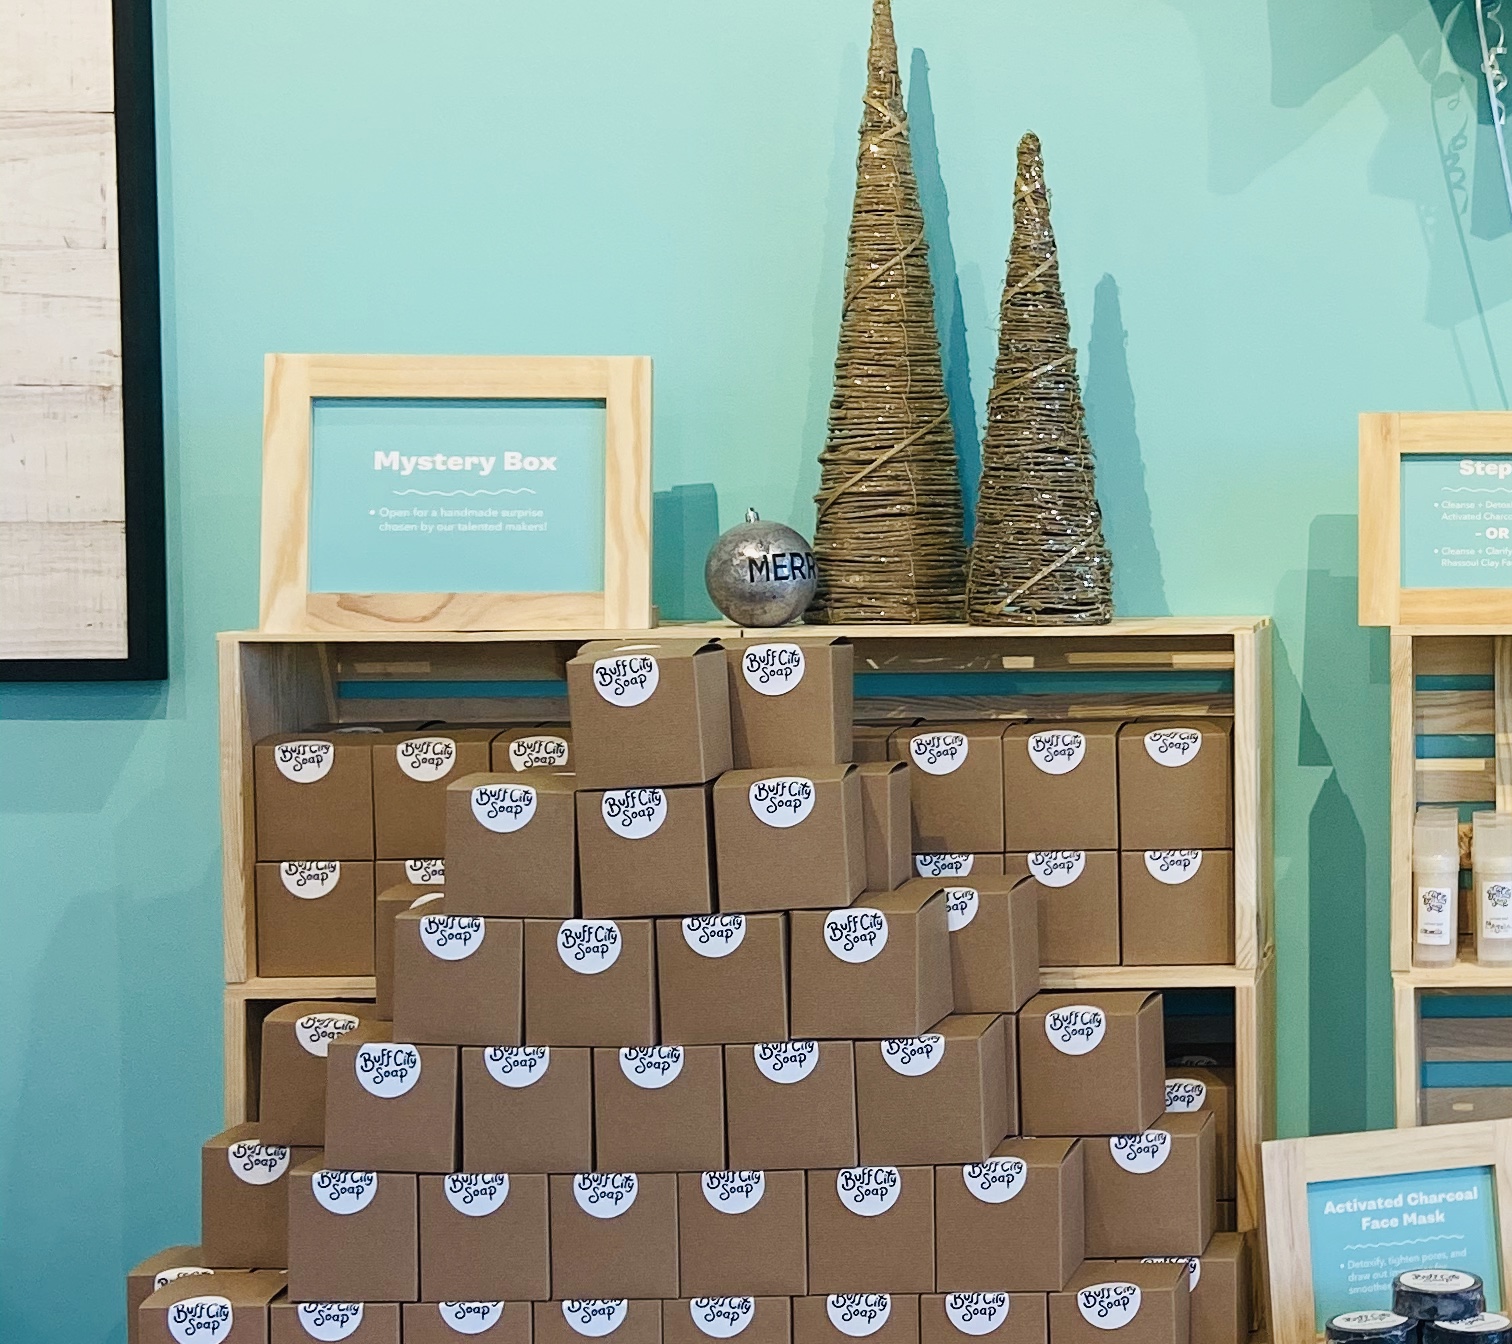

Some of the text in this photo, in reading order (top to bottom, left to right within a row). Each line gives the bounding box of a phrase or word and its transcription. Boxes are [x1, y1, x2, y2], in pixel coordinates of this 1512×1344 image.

[373, 451, 558, 476] Mystery Box
[1459, 459, 1512, 479] Step
[1485, 527, 1510, 540] OR
[747, 650, 800, 672] Buff City
[596, 657, 653, 686] Buff City
[760, 666, 792, 683] Soap
[614, 674, 647, 695] Soap
[475, 788, 533, 806] Buff City
[755, 780, 811, 801] Buff City
[487, 802, 522, 820] Soap
[604, 788, 661, 817] Buff City
[766, 796, 802, 813] Soap
[621, 807, 655, 826] Soap
[561, 925, 617, 948] Buff City
[827, 912, 883, 941] Buff City
[575, 943, 609, 960] Soap
[844, 932, 877, 951] Soap
[1050, 1010, 1102, 1030] Buff City
[1061, 1025, 1094, 1042] Soap
[360, 1049, 417, 1072] Buff City
[373, 1067, 408, 1084] Soap
[841, 1168, 897, 1191] Buff City
[854, 1184, 888, 1202] Soap
[1324, 1186, 1478, 1215] Activated Charcoal
[1361, 1209, 1446, 1231] Face Mask
[174, 1303, 229, 1323] Buff City
[185, 1318, 220, 1335] Soap
